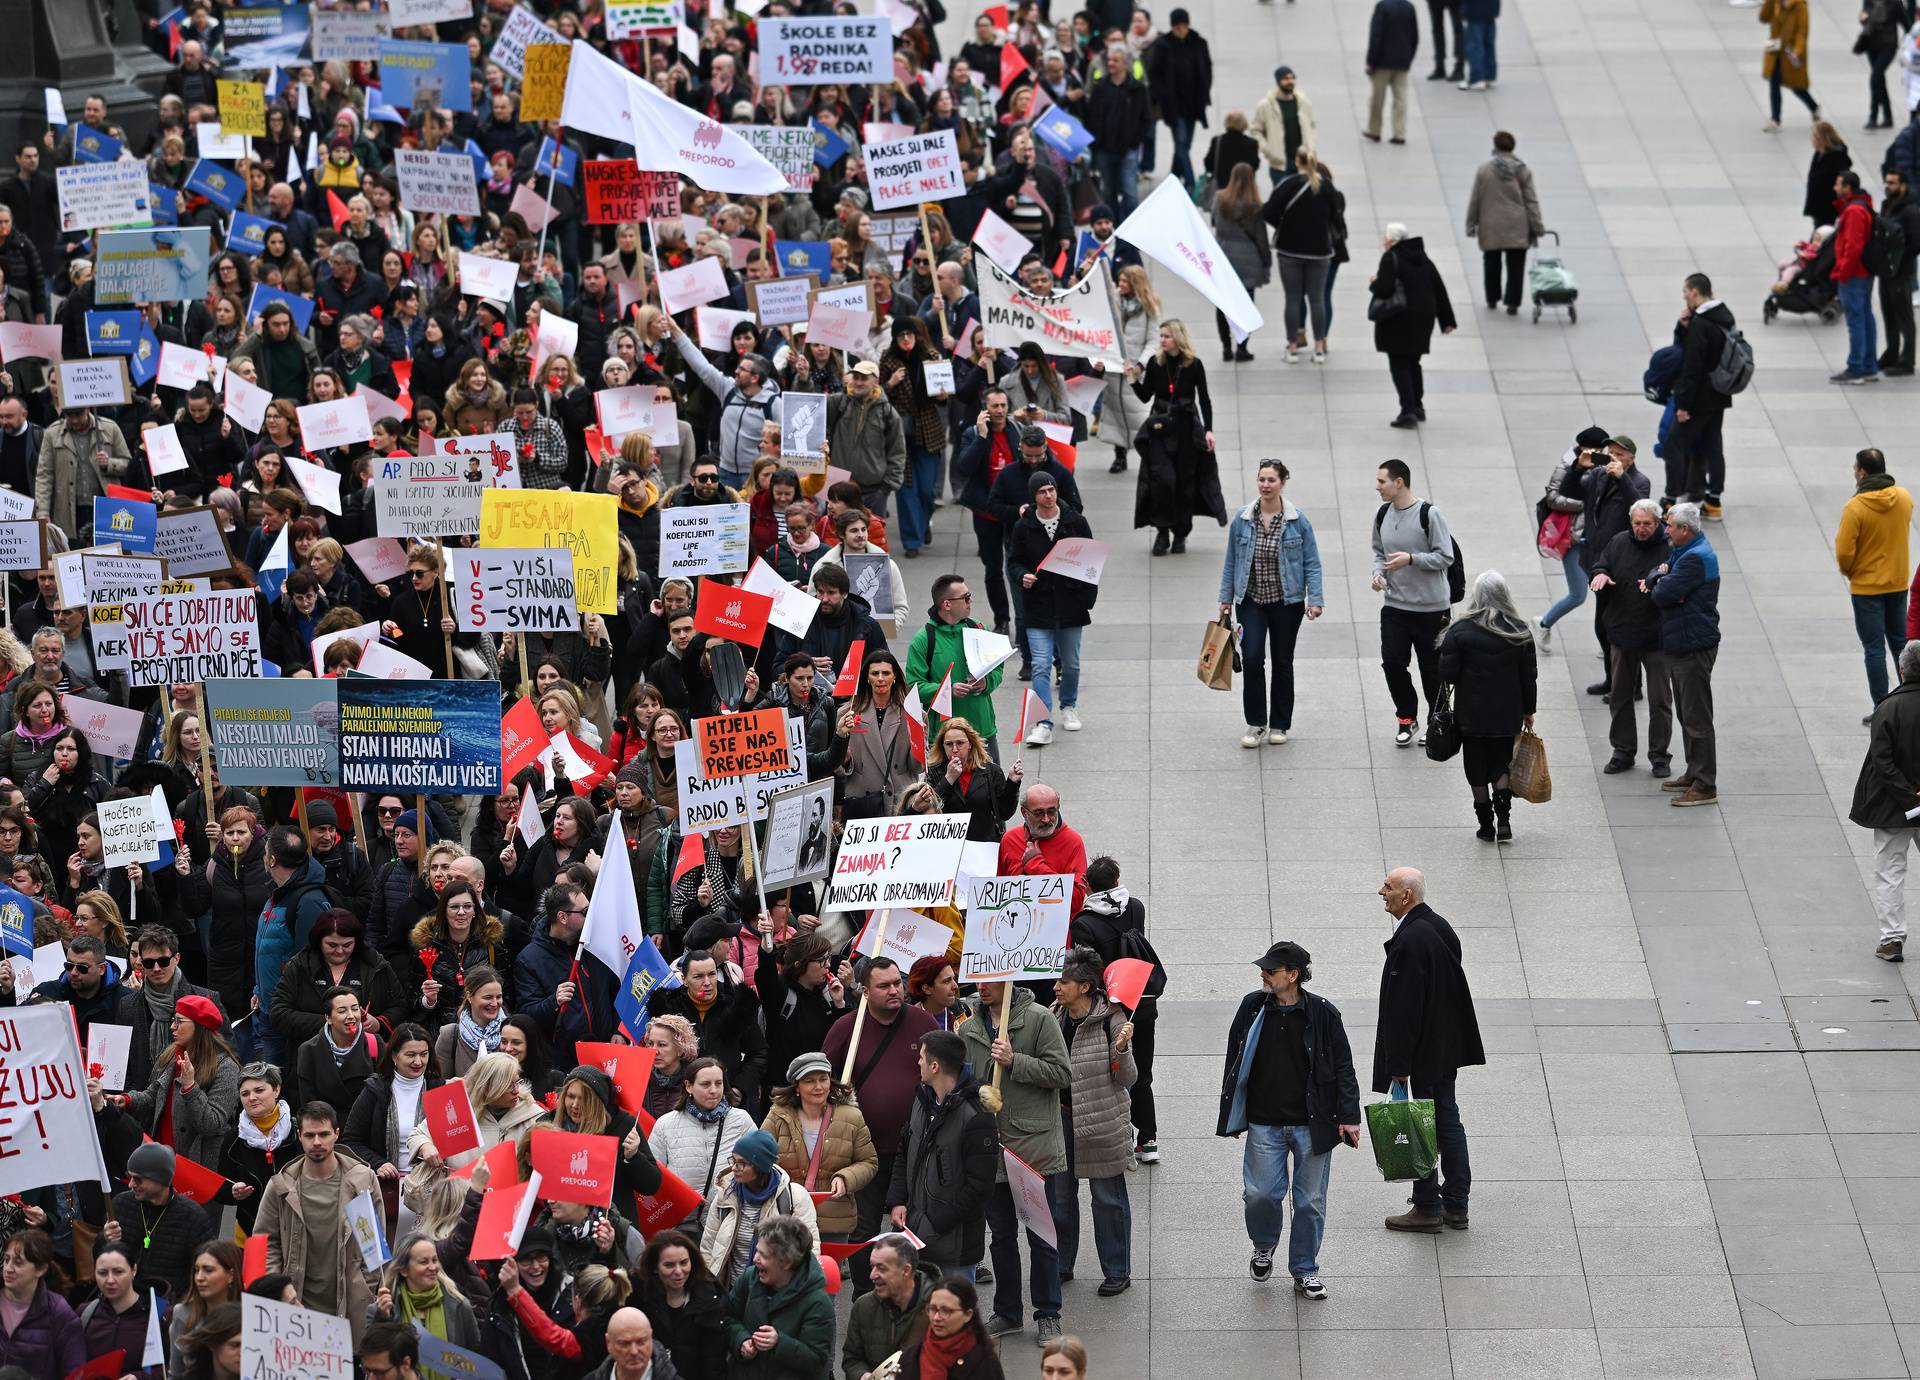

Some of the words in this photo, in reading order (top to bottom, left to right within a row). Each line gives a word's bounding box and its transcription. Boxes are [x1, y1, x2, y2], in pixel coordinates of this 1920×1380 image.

[780, 23, 837, 40] ŠKOLE
[843, 25, 877, 38] BEZ
[789, 43, 869, 56] RADNIKA
[821, 61, 872, 74] REDA!
[753, 130, 772, 144] ME
[778, 130, 814, 145] NETKO
[679, 149, 735, 168] PREPOROD
[869, 143, 906, 161] MASKE
[908, 142, 920, 154] SU
[923, 137, 946, 151] PALE
[873, 160, 923, 180] PROSVJETI
[927, 155, 949, 170] OPET
[920, 176, 948, 193] MALE
[950, 170, 957, 188] !
[844, 296, 864, 306] NAS
[988, 306, 1034, 330] MAMO
[410, 461, 435, 478] PAO
[441, 461, 457, 476] SI
[388, 488, 398, 500] NA
[405, 486, 435, 498] ISPITU
[4, 496, 24, 512] WHAT
[488, 500, 574, 540] JESAM
[672, 519, 698, 527] KOLIKI
[698, 518, 709, 526] SU
[6, 528, 14, 536] SI
[179, 535, 196, 544] STE
[666, 530, 715, 540] KOEFICIJENTI
[166, 546, 193, 556] ISPITU
[682, 542, 700, 550] LIPE
[126, 562, 142, 570] VAM
[470, 560, 480, 578] V
[512, 556, 554, 576] VIŠI
[672, 558, 708, 568] RADOSTI?
[90, 587, 138, 603] NEKIMA
[470, 581, 484, 600] S
[506, 578, 574, 599] STANDARD
[124, 602, 148, 629] SVI
[152, 598, 173, 627] ĆE
[180, 597, 221, 626] DOBITI
[225, 595, 256, 624] PUNO
[471, 604, 487, 627] S
[507, 605, 572, 628] SVIMA
[715, 616, 747, 630] PREPOROD
[172, 626, 222, 656] SAMO
[230, 632, 250, 646] SE
[131, 656, 195, 686] PROSVJETI
[198, 654, 228, 680] CRNO
[232, 647, 260, 678] PIŠE
[213, 709, 239, 722] PITATE
[240, 710, 247, 721] LI
[248, 710, 257, 721] SE
[257, 709, 278, 722] GDJE
[278, 710, 291, 721] SU
[342, 703, 372, 720] ŽIVIMO
[372, 706, 381, 718] LI
[382, 707, 392, 718] MI
[393, 707, 400, 718] U
[402, 708, 433, 720] NEKOM
[216, 724, 276, 745] NESTALI
[277, 724, 319, 745] MLADI
[342, 720, 398, 732] PARALELNOM
[398, 721, 442, 734] SVEMIRU?
[706, 714, 758, 736] HTJELI
[342, 736, 382, 758] STAN
[382, 736, 388, 758] I
[390, 737, 443, 759] HRANA
[444, 738, 450, 760] I
[505, 736, 534, 764] PREPOROD
[709, 736, 736, 754] STE
[746, 730, 777, 750] NAS
[221, 747, 328, 769] ZNANSTVENICI?
[705, 748, 789, 775] PREVESLATI
[344, 764, 390, 786] NAMA
[392, 758, 458, 786] KOŠTAJU
[458, 760, 498, 788] VIŠE!
[104, 806, 142, 822] HOĆEMO
[686, 800, 728, 825] RADIO
[736, 796, 746, 814] B
[102, 820, 156, 840] KOEFICIJENT
[844, 822, 865, 845] ŠTO
[868, 824, 878, 842] SI
[884, 822, 910, 842] BEZ
[916, 818, 969, 840] STRUČNOG
[836, 852, 887, 877] ZNANJA
[890, 846, 901, 870] ?
[828, 882, 878, 904] MINISTAR
[884, 878, 953, 902] OBRAZOVANJA!
[973, 878, 1031, 907] VRIJEME
[1037, 877, 1065, 898] ZA
[883, 938, 918, 959] PREPOROD
[963, 950, 1023, 974] TEHNIČKO
[447, 1125, 470, 1137] PREPOROD
[560, 1176, 598, 1188] PREPOROD
[648, 1200, 674, 1224] PREPOROD
[254, 1304, 279, 1334] Di
[286, 1313, 312, 1341] Si
[270, 1336, 342, 1375] RADOSTI
